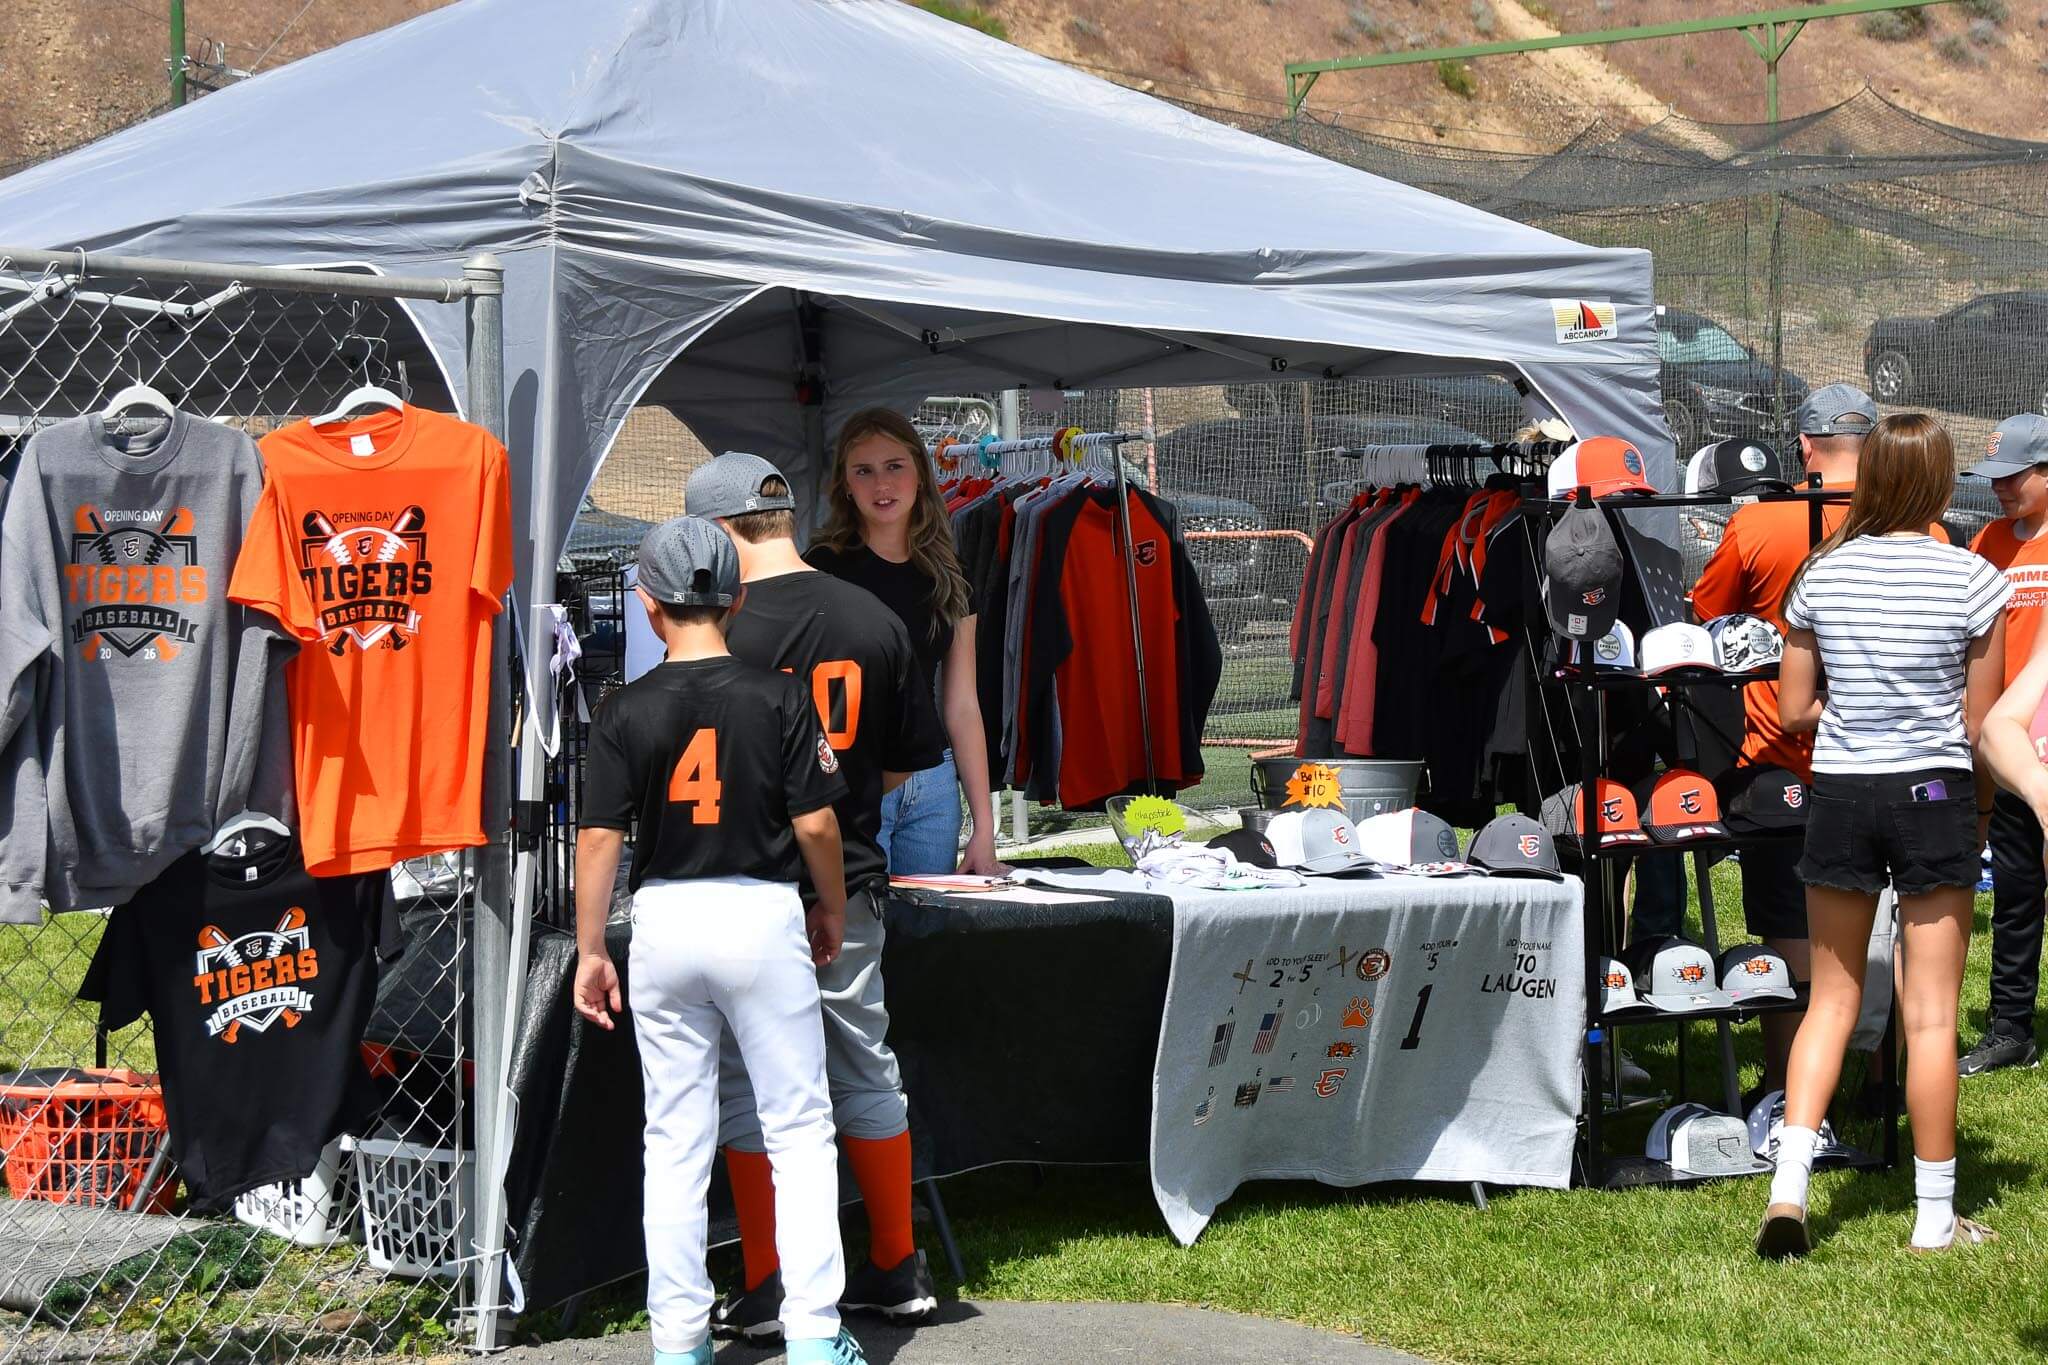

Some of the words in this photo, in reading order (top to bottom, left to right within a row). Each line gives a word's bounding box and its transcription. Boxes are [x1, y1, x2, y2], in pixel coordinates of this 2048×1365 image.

[1564, 330, 1608, 340] ABCCANOPY
[104, 510, 141, 522] OPENING
[142, 510, 164, 522] DAY
[332, 511, 373, 523] OPENING
[375, 511, 395, 522] DAY
[64, 564, 208, 604] TIGERS
[301, 561, 433, 603] TIGERS
[86, 610, 176, 628] BASEBALL
[381, 639, 391, 649] 26
[100, 648, 112, 659] 20
[144, 648, 156, 659] 26
[780, 660, 862, 750] 0
[669, 728, 721, 824] 4
[1300, 770, 1331, 782] Belts
[1304, 784, 1326, 797] $10
[194, 949, 319, 1004] TIGERS
[1269, 969, 1284, 988] 2
[1313, 987, 1321, 996] C
[1481, 973, 1557, 999] LAUGEN
[222, 991, 296, 1018] BASEBALL
[1277, 999, 1284, 1008] B
[1227, 1006, 1234, 1016] A
[1400, 984, 1434, 1050] 1
[1290, 1052, 1298, 1062] F
